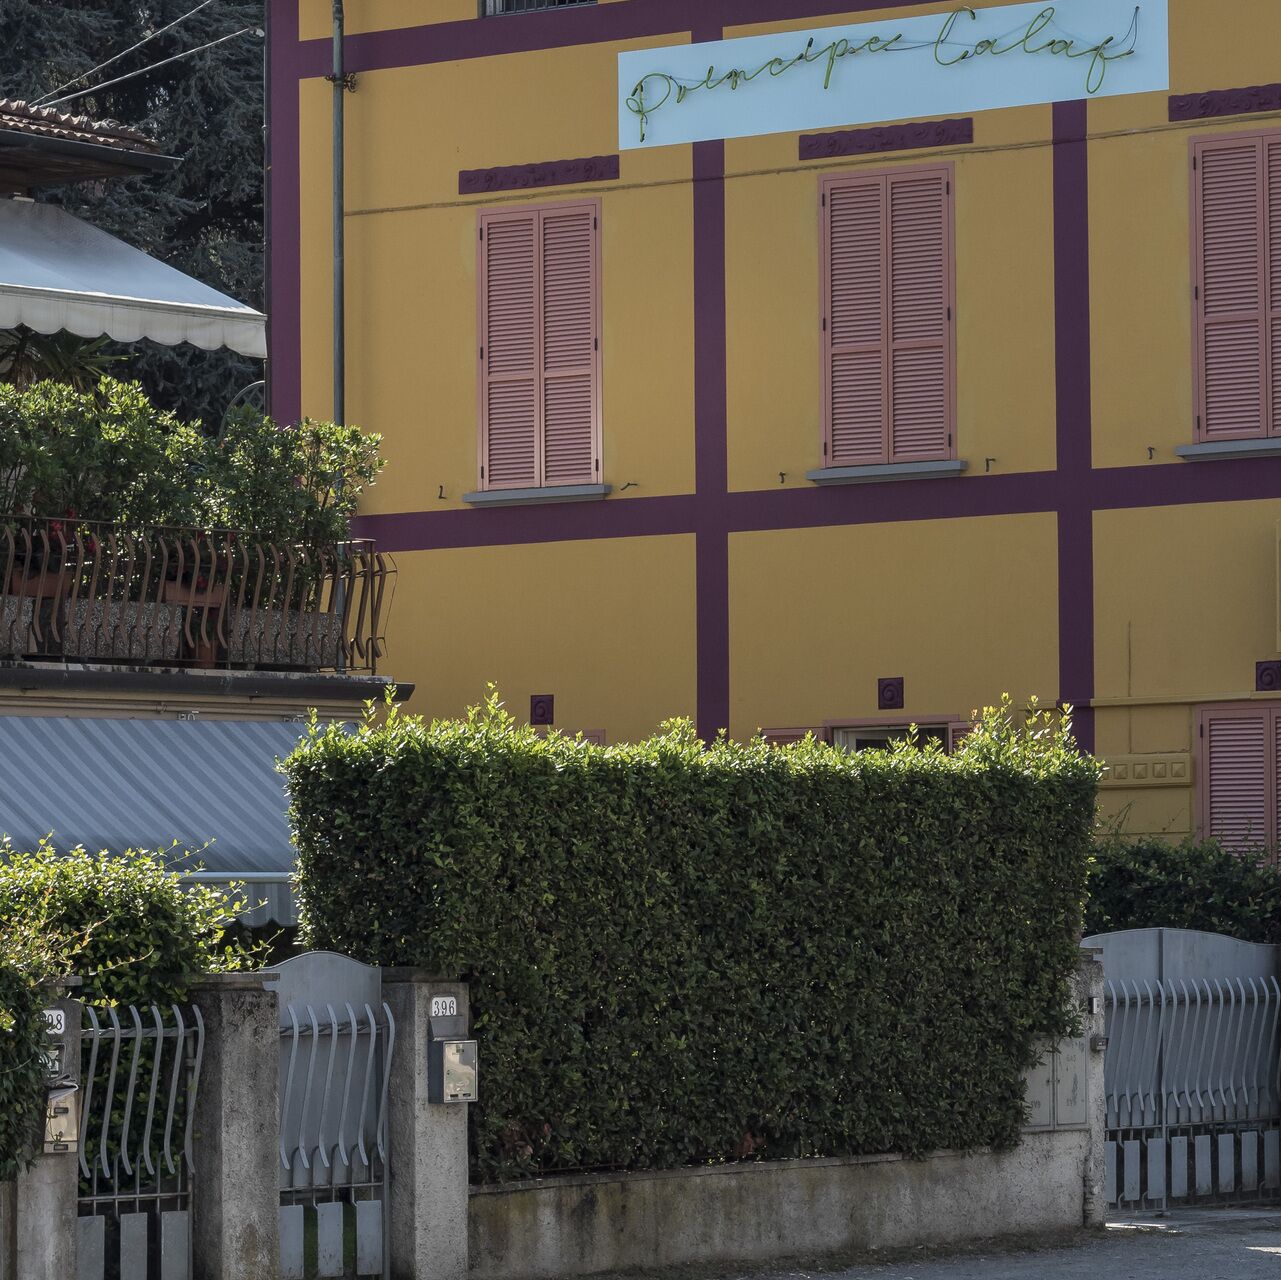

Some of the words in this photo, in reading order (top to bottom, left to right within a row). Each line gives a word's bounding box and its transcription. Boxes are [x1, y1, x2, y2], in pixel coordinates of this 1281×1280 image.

[626, 33, 902, 142] Principe
[934, 6, 1136, 94] Calaf
[433, 999, 456, 1016] 396
[46, 1013, 63, 1031] 98
